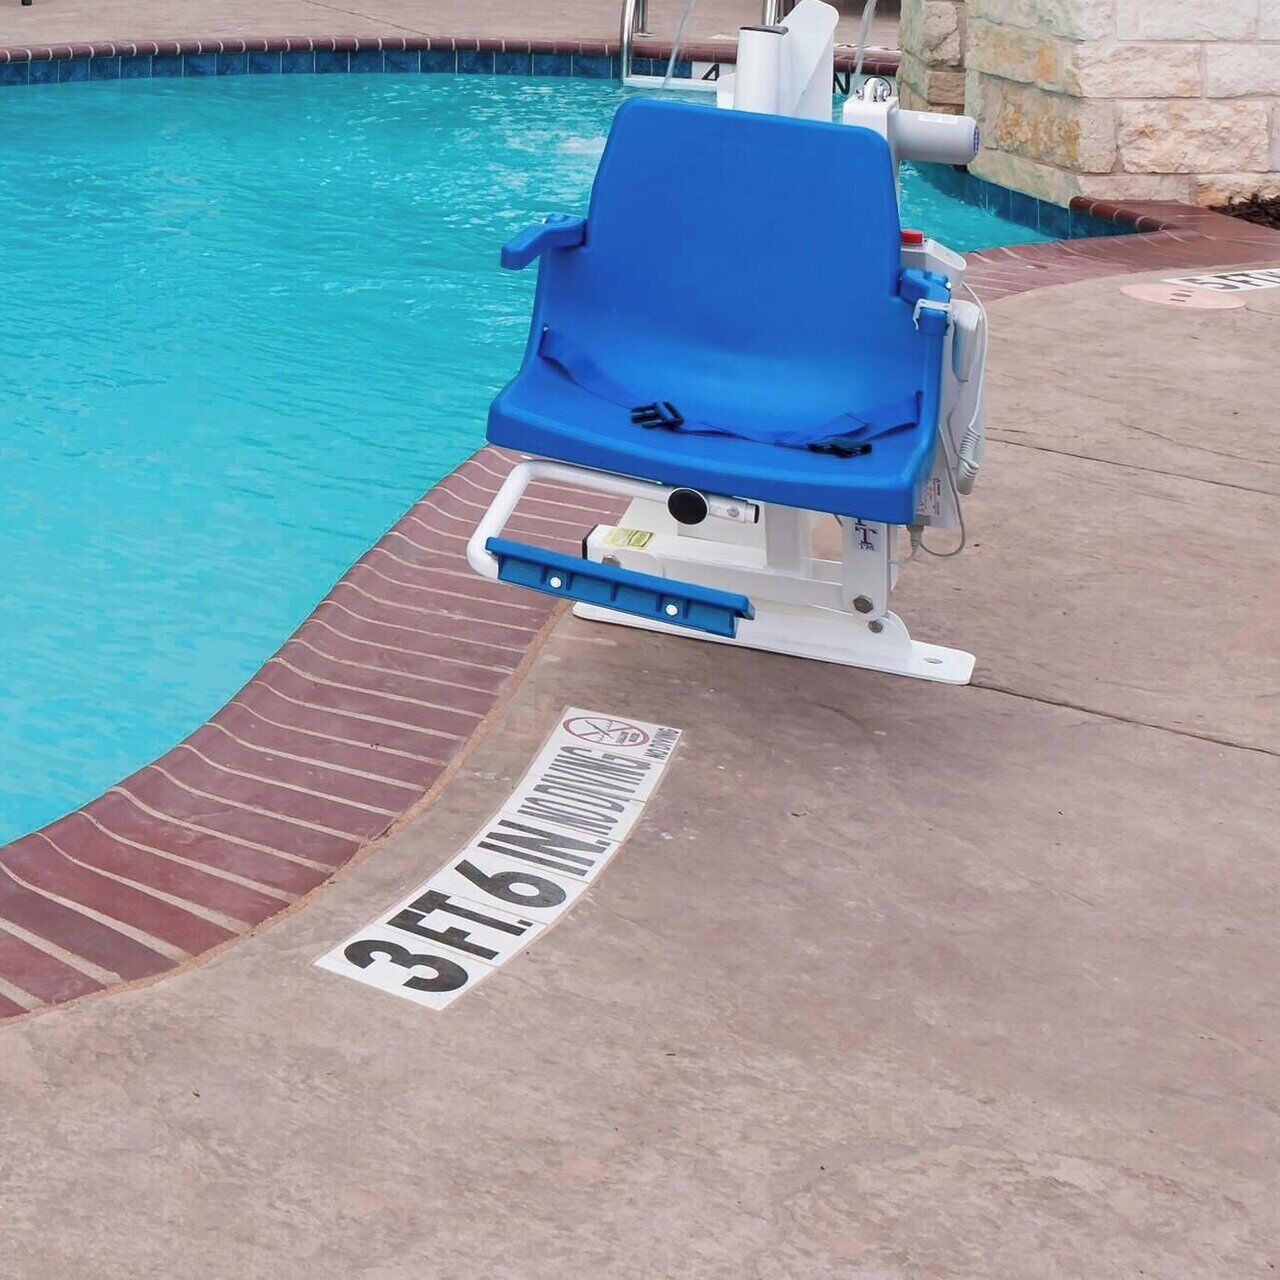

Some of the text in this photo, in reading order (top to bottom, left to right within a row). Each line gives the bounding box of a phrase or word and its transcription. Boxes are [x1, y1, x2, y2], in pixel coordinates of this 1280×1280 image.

[343, 746, 652, 993] 3 FT. 6 IN. NO DIVING
